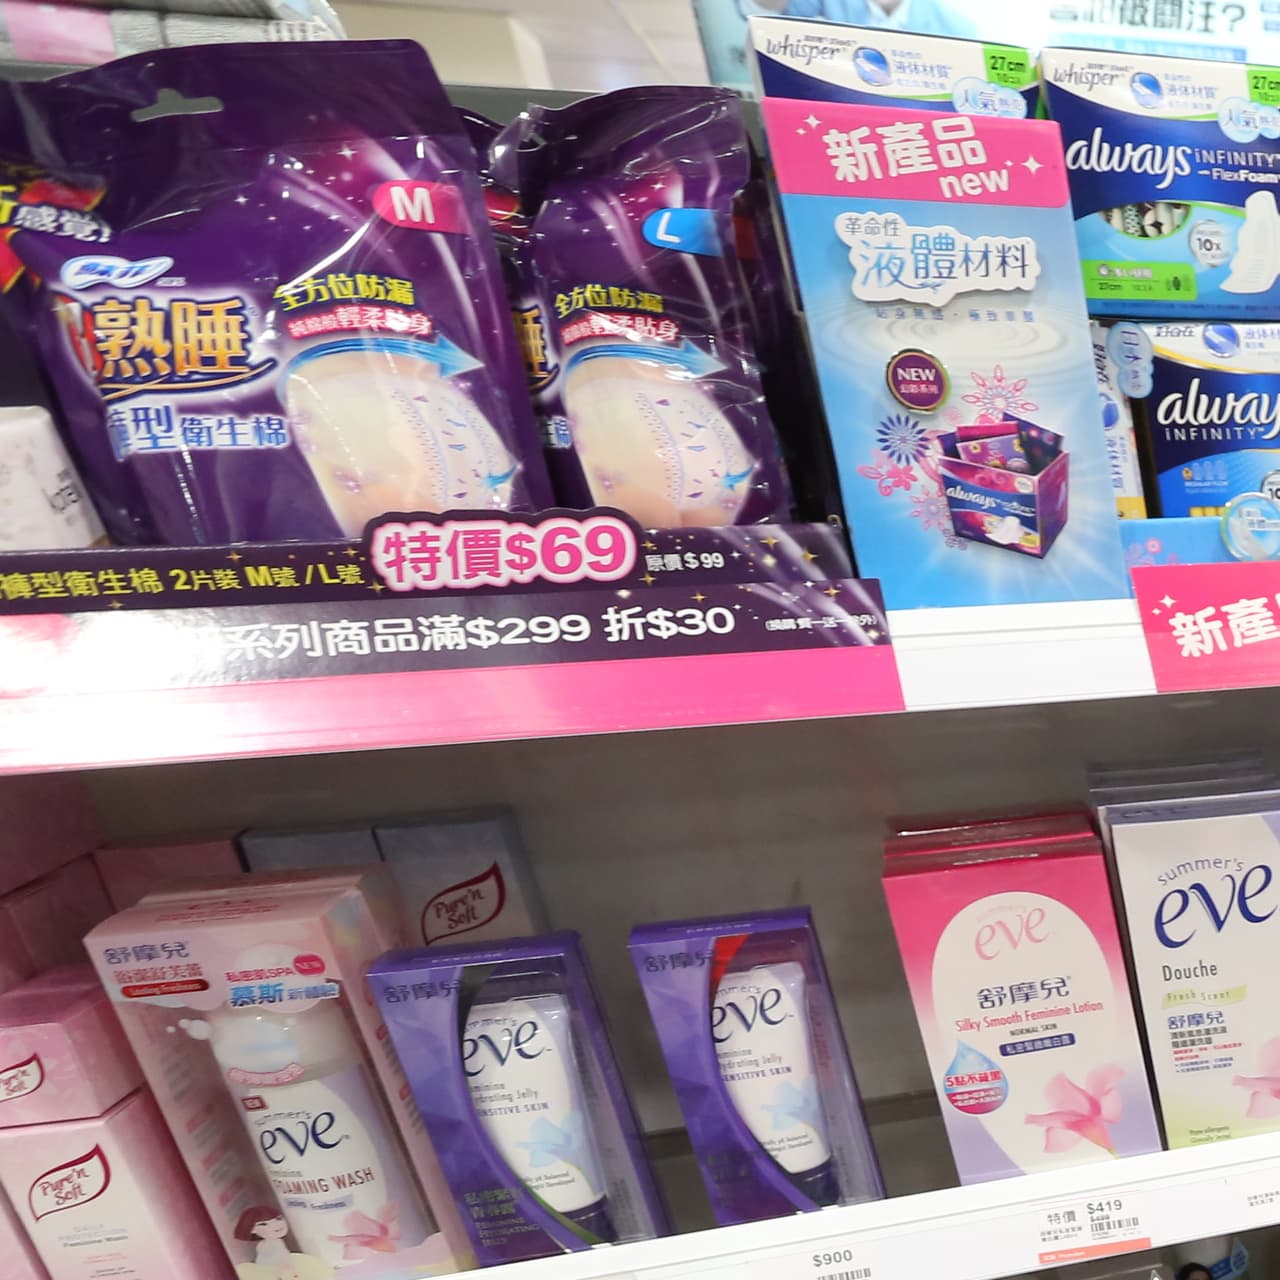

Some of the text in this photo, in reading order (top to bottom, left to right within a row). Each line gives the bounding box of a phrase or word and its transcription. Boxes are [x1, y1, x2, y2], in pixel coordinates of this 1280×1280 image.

[823, 117, 988, 184] 新產品
[939, 170, 1010, 199] new
[389, 186, 436, 224] M
[655, 212, 682, 243] L
[844, 217, 902, 236] 革命性
[858, 233, 1029, 288] 液體材料
[274, 274, 415, 311] 全方位防漏
[93, 298, 251, 378] 熟睡
[897, 367, 935, 383] NEW
[602, 605, 737, 642] 折$30
[1157, 857, 1246, 887] summer's
[447, 906, 478, 930] Soft
[1154, 863, 1278, 949] eve
[974, 906, 1048, 961] eve
[1162, 960, 1218, 983] Douche
[976, 976, 1070, 1009] 舒摩兒
[955, 1001, 1104, 1032] Silky Smooth Feminine Lotion
[259, 1108, 344, 1166] eve
[333, 1165, 376, 1189] WASH
[1046, 1199, 1122, 1226] 特價 $419
[812, 1249, 854, 1269] $900
